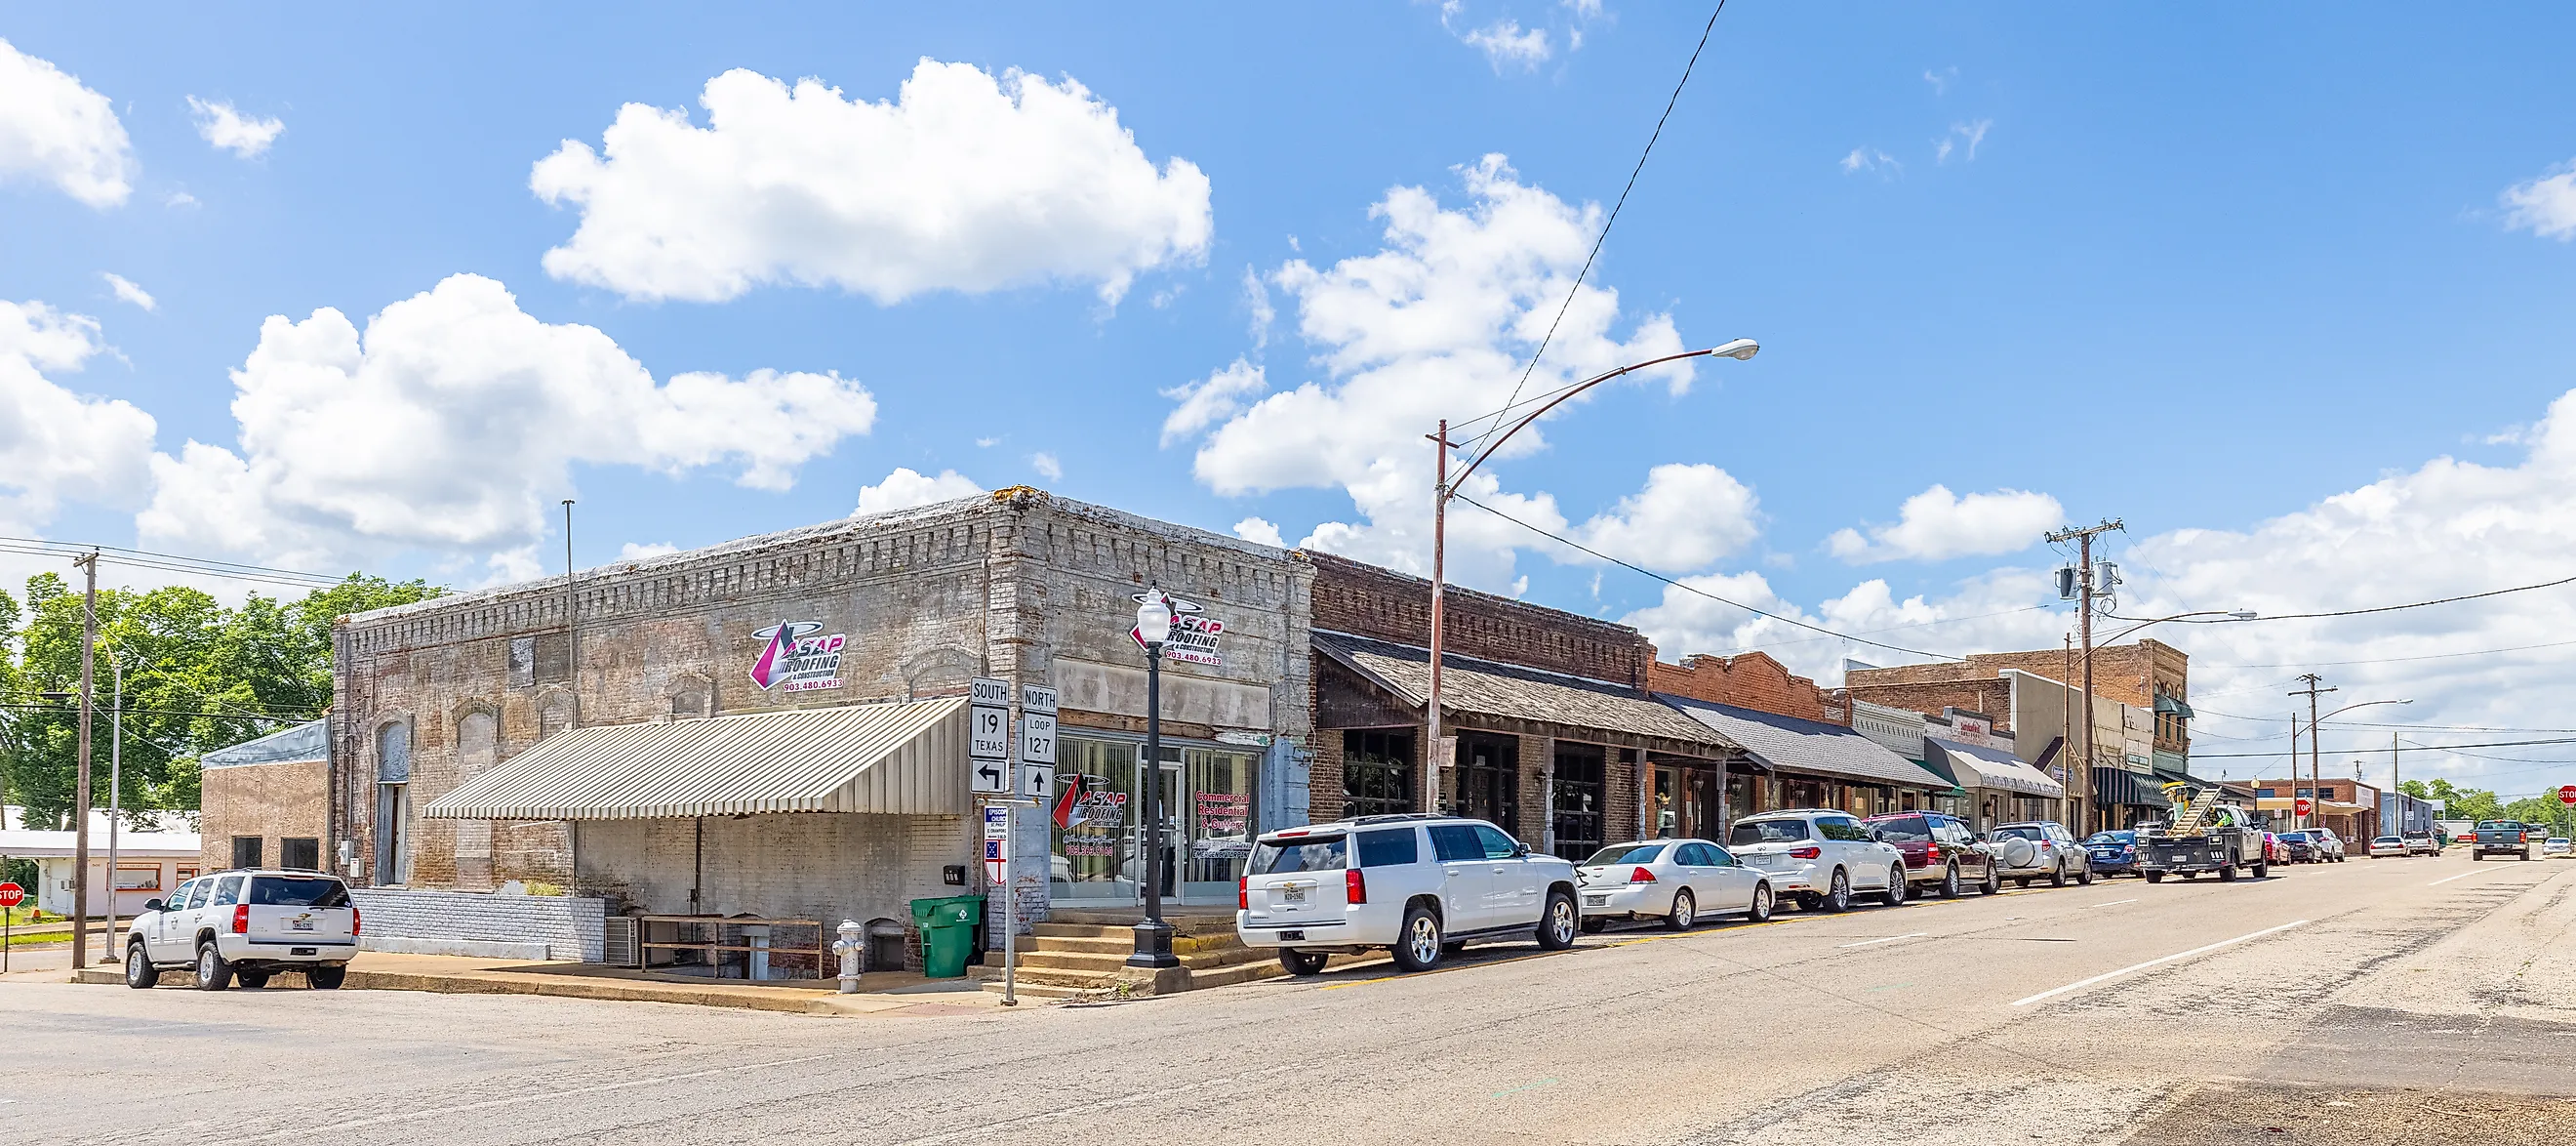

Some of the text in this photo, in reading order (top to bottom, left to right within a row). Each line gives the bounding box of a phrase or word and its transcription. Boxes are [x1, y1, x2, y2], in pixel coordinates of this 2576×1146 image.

[1169, 616, 1223, 634] ASAP
[1167, 632, 1218, 647] ROOFING
[781, 637, 843, 659] ASAP
[1180, 644, 1215, 653] CONSTRUCTION
[784, 655, 839, 674] ROOFING
[1166, 651, 1222, 665] 903.480.6933
[797, 670, 834, 679] CONSTRUCTION
[784, 679, 843, 691] 903.480.6933
[974, 683, 1007, 701] SOUTH
[1026, 690, 1056, 708] NORTH
[981, 714, 998, 734] 19
[1029, 719, 1051, 730] LOOP
[976, 740, 1003, 752] TEXAS
[1029, 737, 1050, 754] 127
[1079, 792, 1126, 807] ASAP
[1196, 791, 1250, 803] Commercial
[1081, 807, 1123, 820] ROOFING
[1198, 804, 1249, 817] Residential
[1202, 818, 1245, 831] & Gutters
[1192, 849, 1227, 858] EMERGENCY
